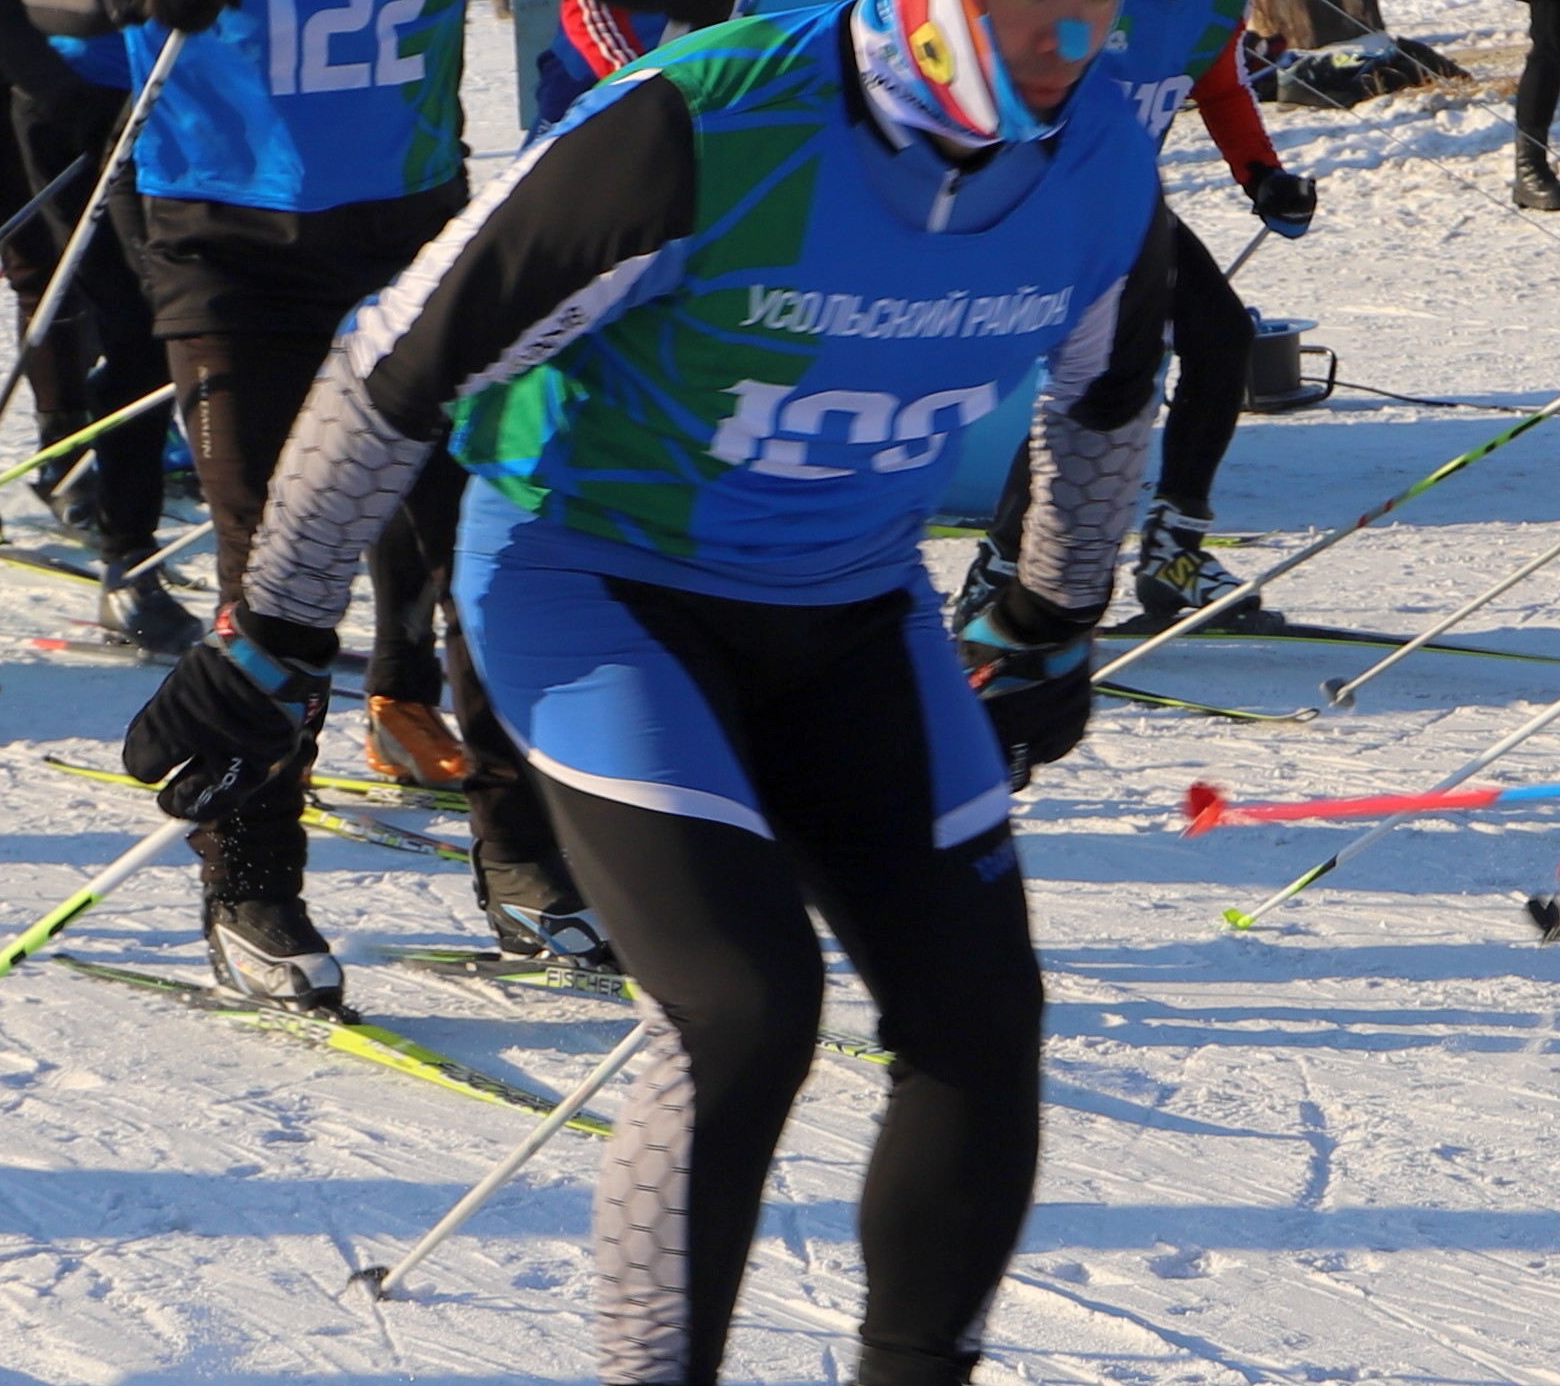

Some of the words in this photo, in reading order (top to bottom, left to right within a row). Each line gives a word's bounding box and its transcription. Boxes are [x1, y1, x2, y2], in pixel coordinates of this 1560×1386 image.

[739, 284, 971, 339] УСОЛЬСКИЙ
[961, 283, 1075, 339] РАЙОН
[546, 966, 623, 998] FISCHER
